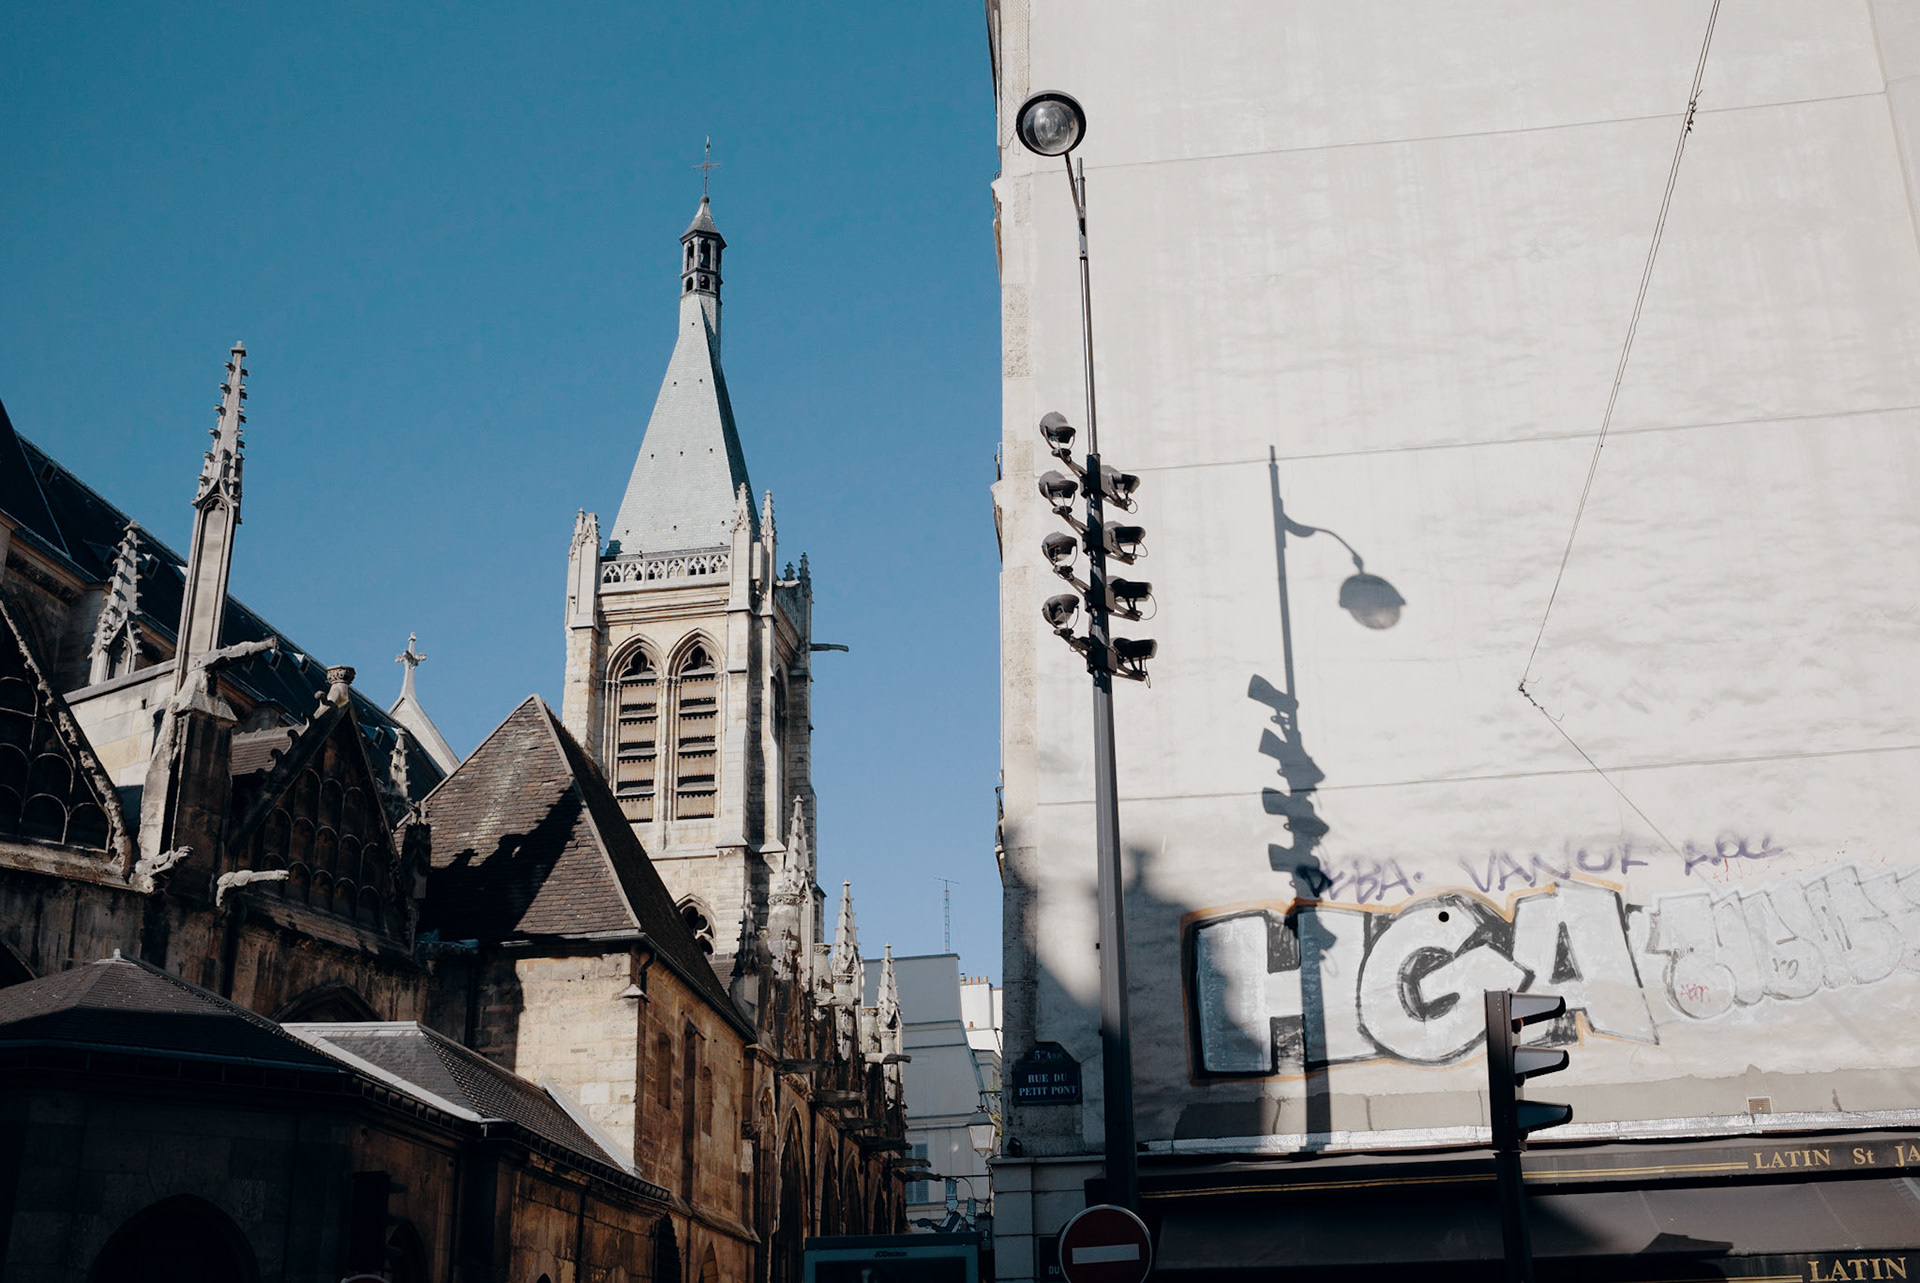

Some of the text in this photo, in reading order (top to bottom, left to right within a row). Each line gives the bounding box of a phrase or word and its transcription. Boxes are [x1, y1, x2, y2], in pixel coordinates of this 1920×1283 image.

[1027, 1072, 1067, 1084] RUE DU
[1018, 1085, 1077, 1096] PETIT PONT
[1753, 1149, 1831, 1169] LATIN
[1852, 1147, 1876, 1165] St
[1807, 1256, 1908, 1283] LATIN
